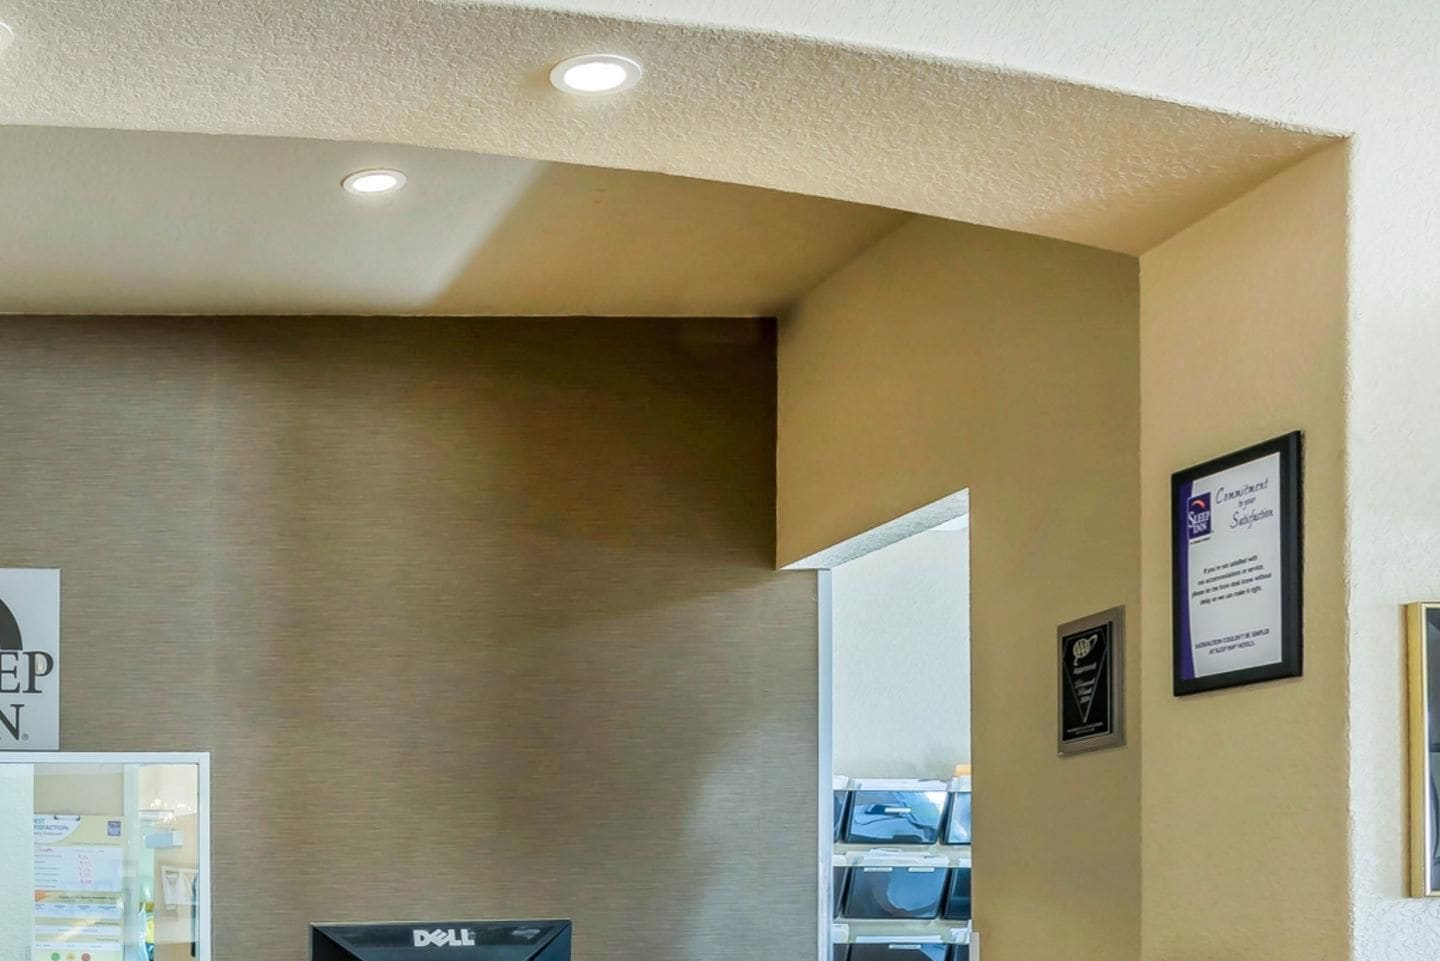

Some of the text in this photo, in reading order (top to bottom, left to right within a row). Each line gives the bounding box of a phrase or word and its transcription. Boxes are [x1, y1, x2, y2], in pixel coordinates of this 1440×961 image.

[1216, 477, 1268, 504] Commitment
[1189, 511, 1210, 527] SLEEP
[1230, 508, 1273, 529] Satisfaction
[413, 928, 476, 948] DELL
